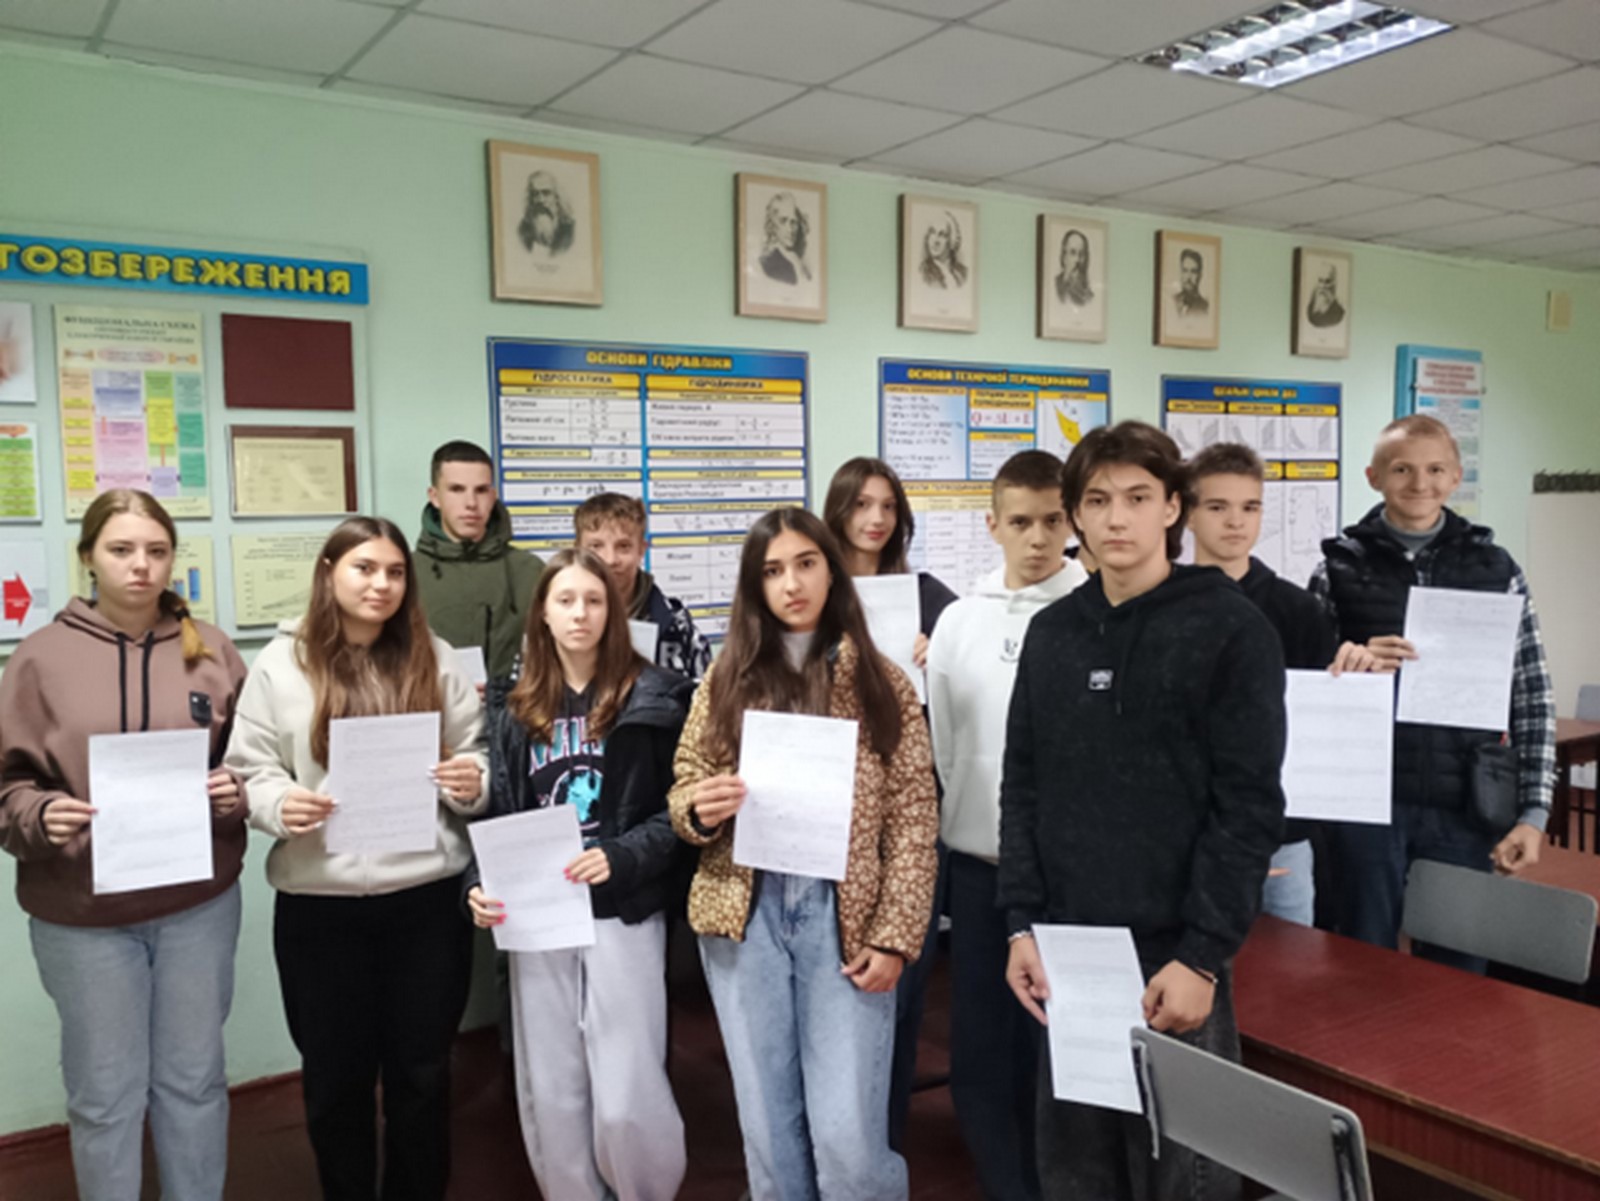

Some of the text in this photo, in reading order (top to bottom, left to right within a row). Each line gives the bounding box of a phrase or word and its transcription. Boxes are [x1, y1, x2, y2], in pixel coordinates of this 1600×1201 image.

[586, 351, 732, 371] ОСНОВИ ГІДРАВЛІКИ
[532, 373, 613, 384] ГІДРОСТАТИКА
[907, 368, 953, 380] ОСНОВИ
